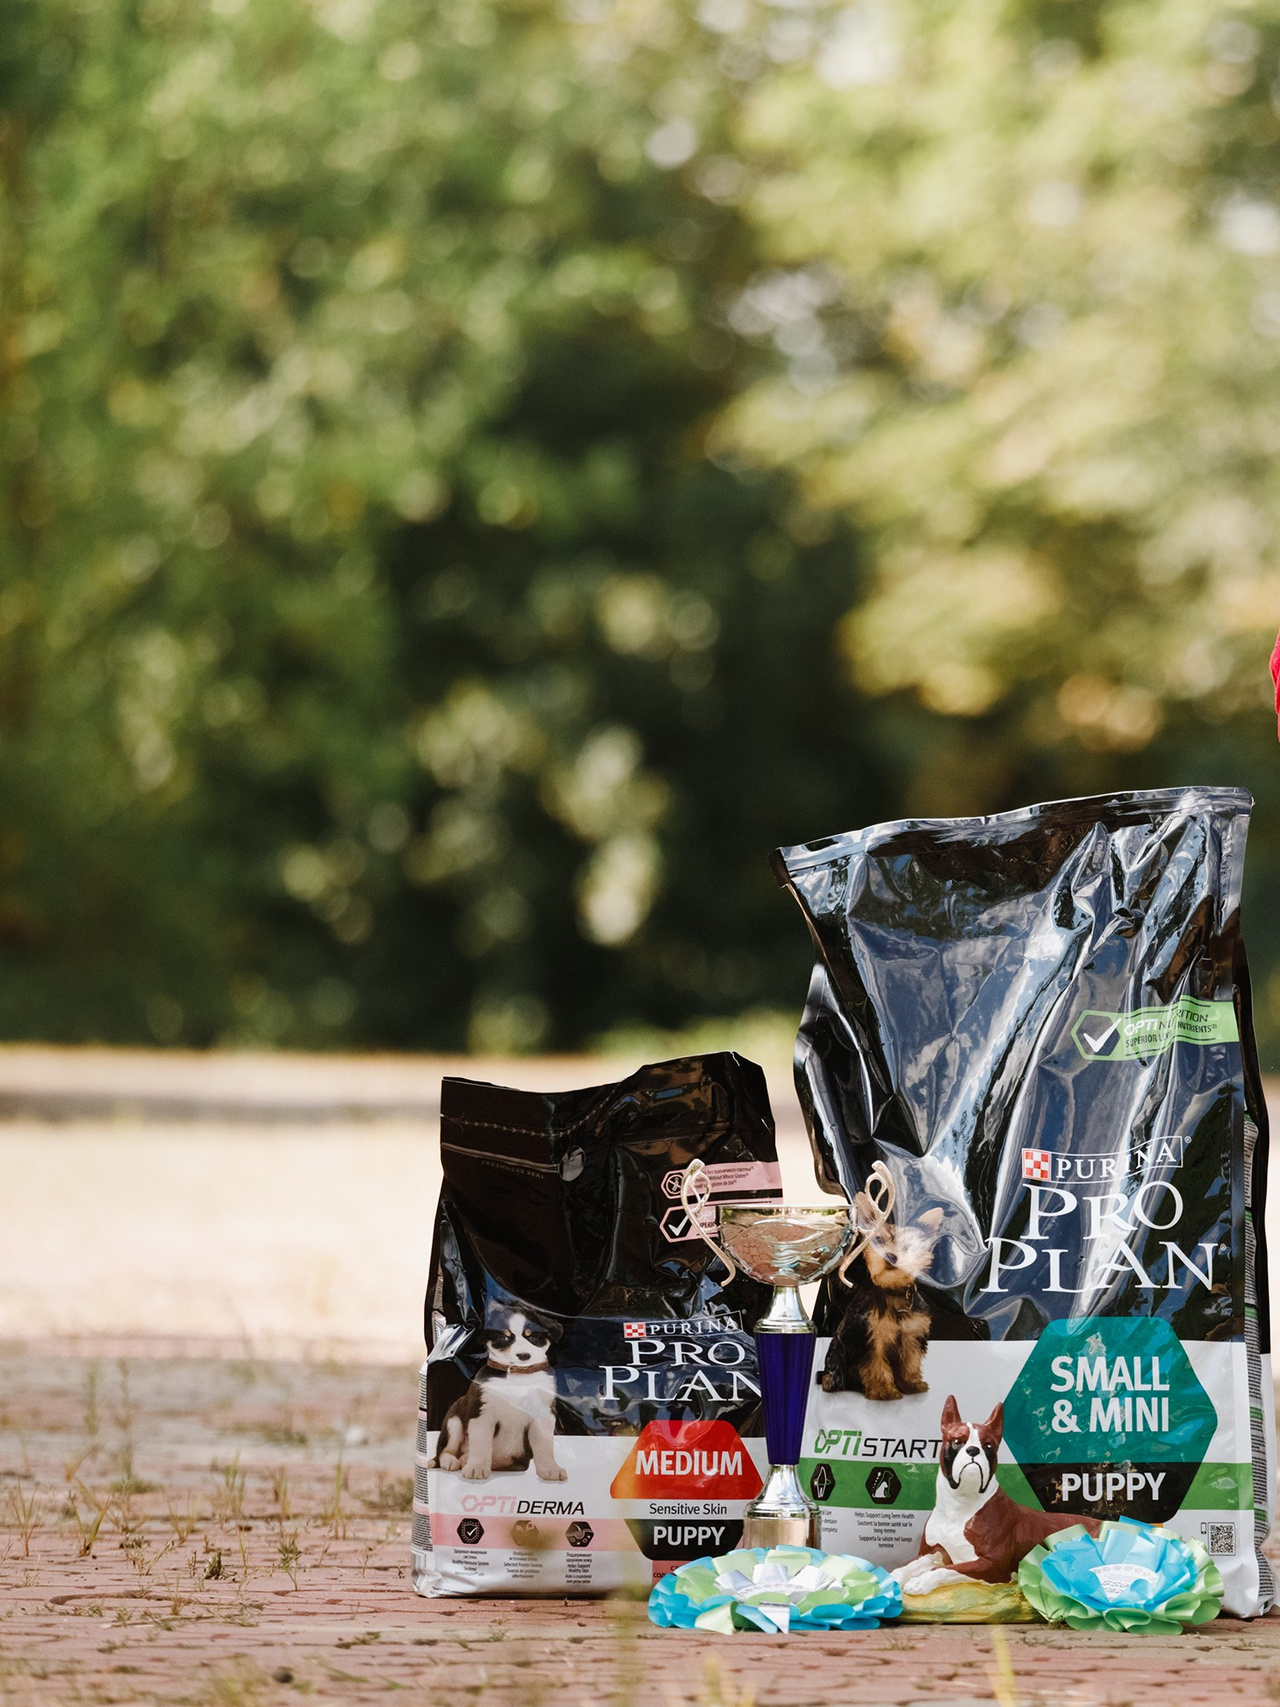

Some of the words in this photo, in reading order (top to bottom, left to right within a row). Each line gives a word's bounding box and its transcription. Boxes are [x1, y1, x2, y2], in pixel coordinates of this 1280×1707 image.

[1125, 1033, 1158, 1048] SUPERIOR
[526, 1170, 545, 1179] SEAL
[1056, 1141, 1177, 1180] PURINA
[1020, 1180, 1184, 1240] PRO
[979, 1236, 1218, 1293] PLAN
[650, 1316, 738, 1335] PURINA
[625, 1339, 746, 1367] PRO
[599, 1365, 762, 1402] PLAN
[1050, 1355, 1170, 1393] SMALL
[1051, 1399, 1082, 1434] &
[1089, 1397, 1169, 1433] MINI
[635, 1450, 743, 1476] MEDIUM
[1062, 1472, 1166, 1502] PUPPY
[649, 1503, 701, 1515] Sensitive
[703, 1503, 727, 1515] Skin
[865, 1511, 880, 1519] Support
[653, 1526, 726, 1546] PUPPY
